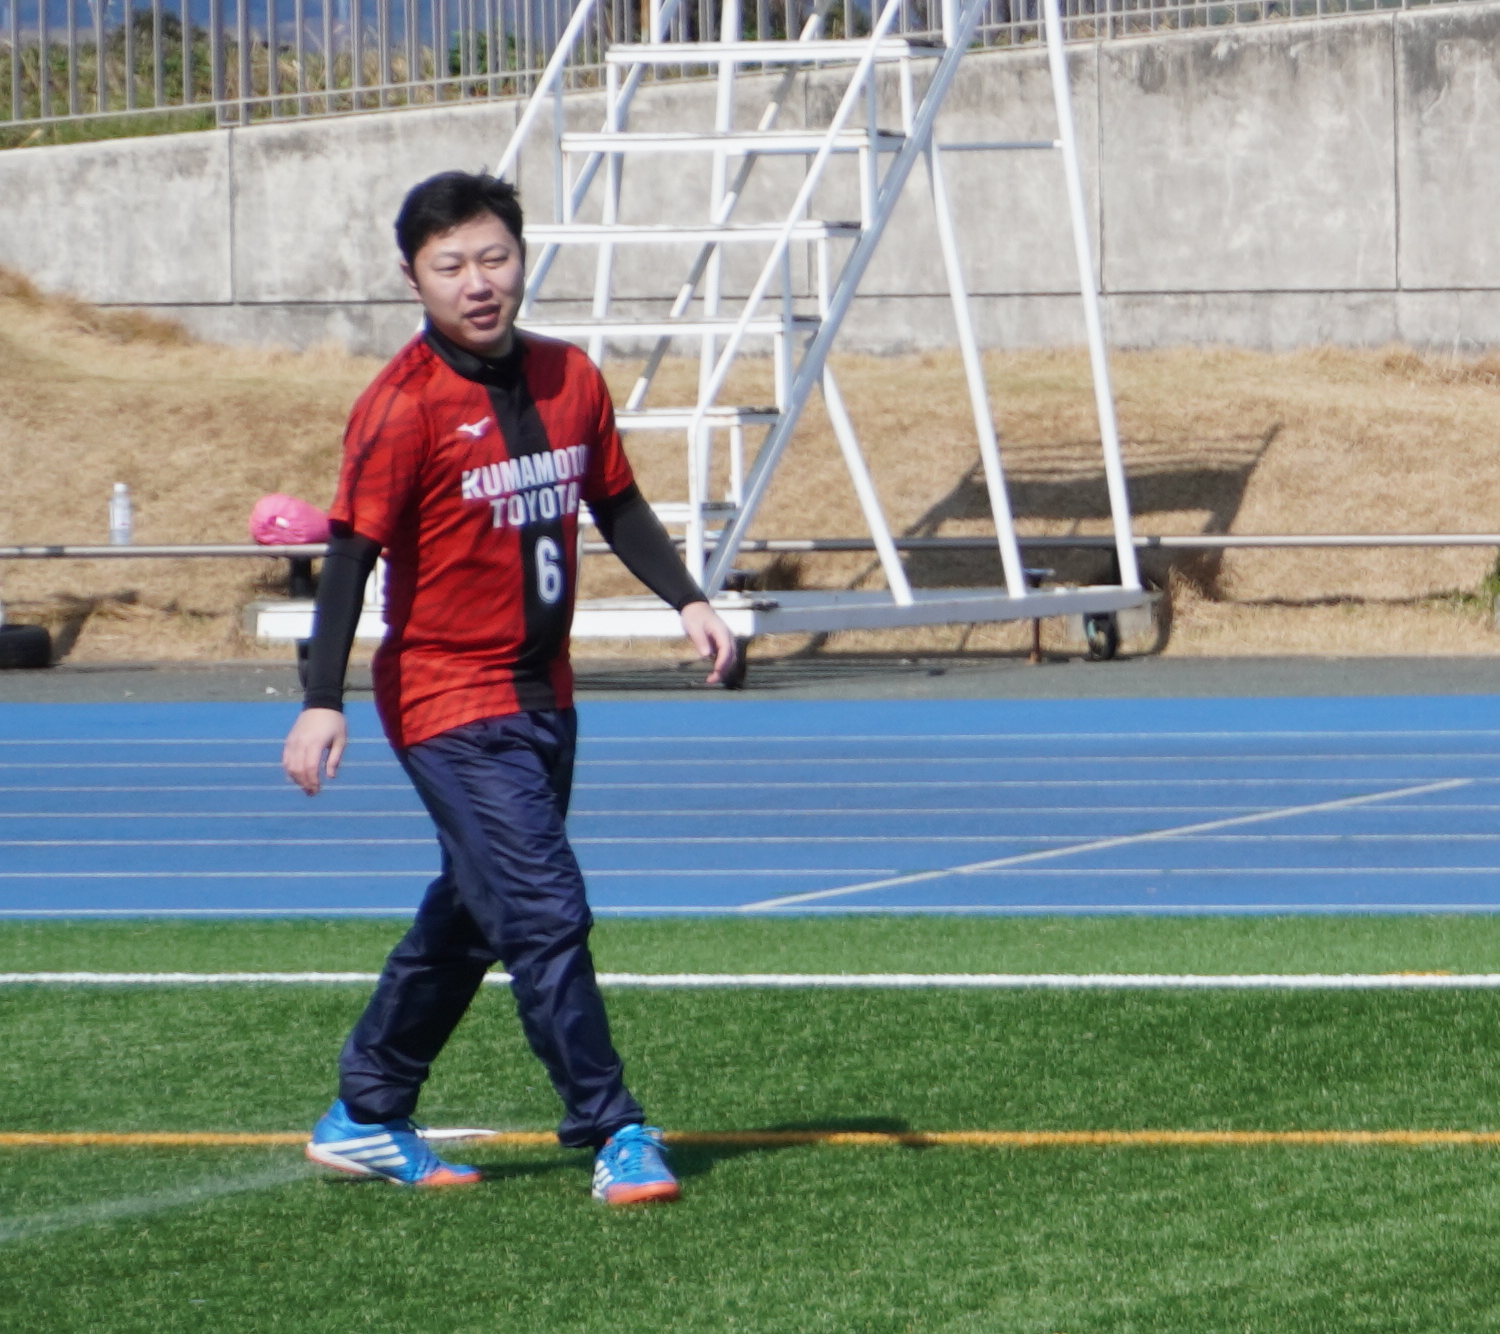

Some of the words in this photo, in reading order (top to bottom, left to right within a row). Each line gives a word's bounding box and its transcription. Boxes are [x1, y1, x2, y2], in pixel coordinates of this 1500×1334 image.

[461, 443, 588, 500] KUMAMOTO
[489, 481, 579, 528] TOYOTA
[535, 535, 563, 604] 6
